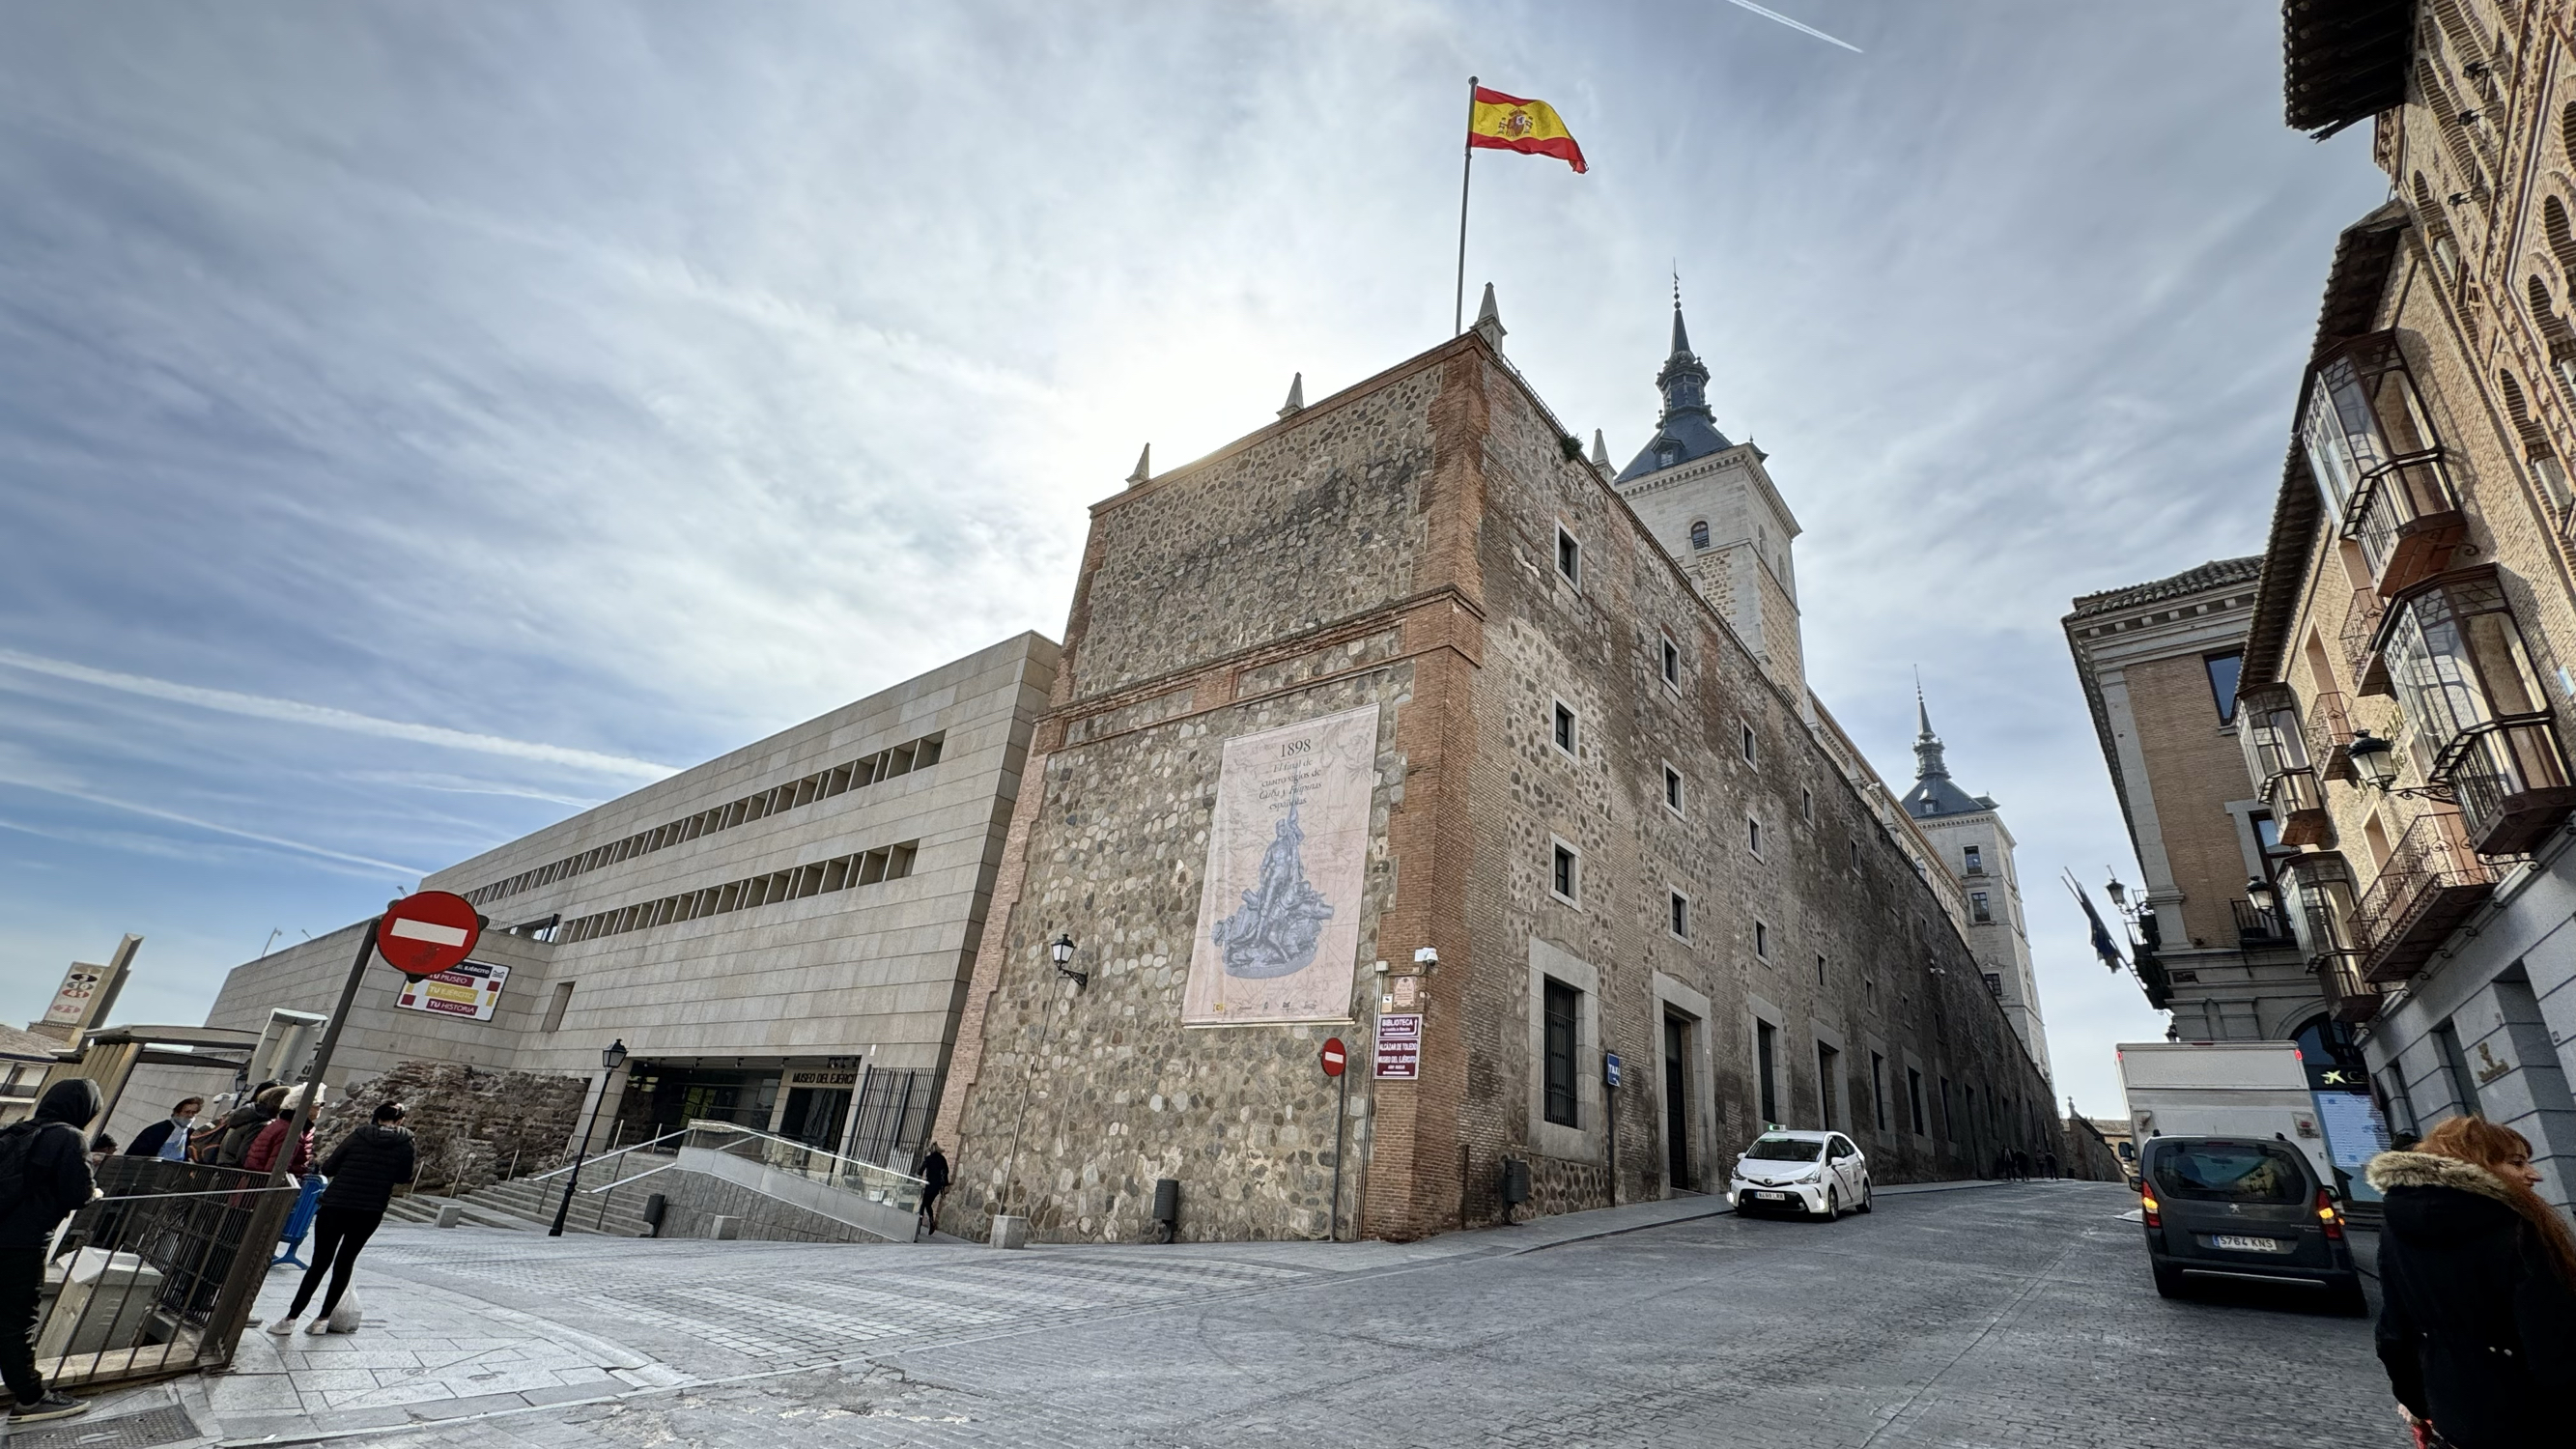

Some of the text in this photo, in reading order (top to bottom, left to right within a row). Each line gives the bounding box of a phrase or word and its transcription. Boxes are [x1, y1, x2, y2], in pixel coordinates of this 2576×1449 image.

[1281, 738, 1312, 757] 1898
[1303, 757, 1314, 767] de
[1311, 768, 1321, 778] de
[440, 974, 467, 984] MUSEO
[440, 988, 475, 1000] EJÉRCITO
[440, 1003, 475, 1013] HISTORIA
[1381, 1018, 1413, 1027] BIBLIOTECA
[792, 1072, 816, 1084] MUSEO
[815, 1072, 829, 1084] DEL
[2221, 1236, 2274, 1249] 5764 KNS
